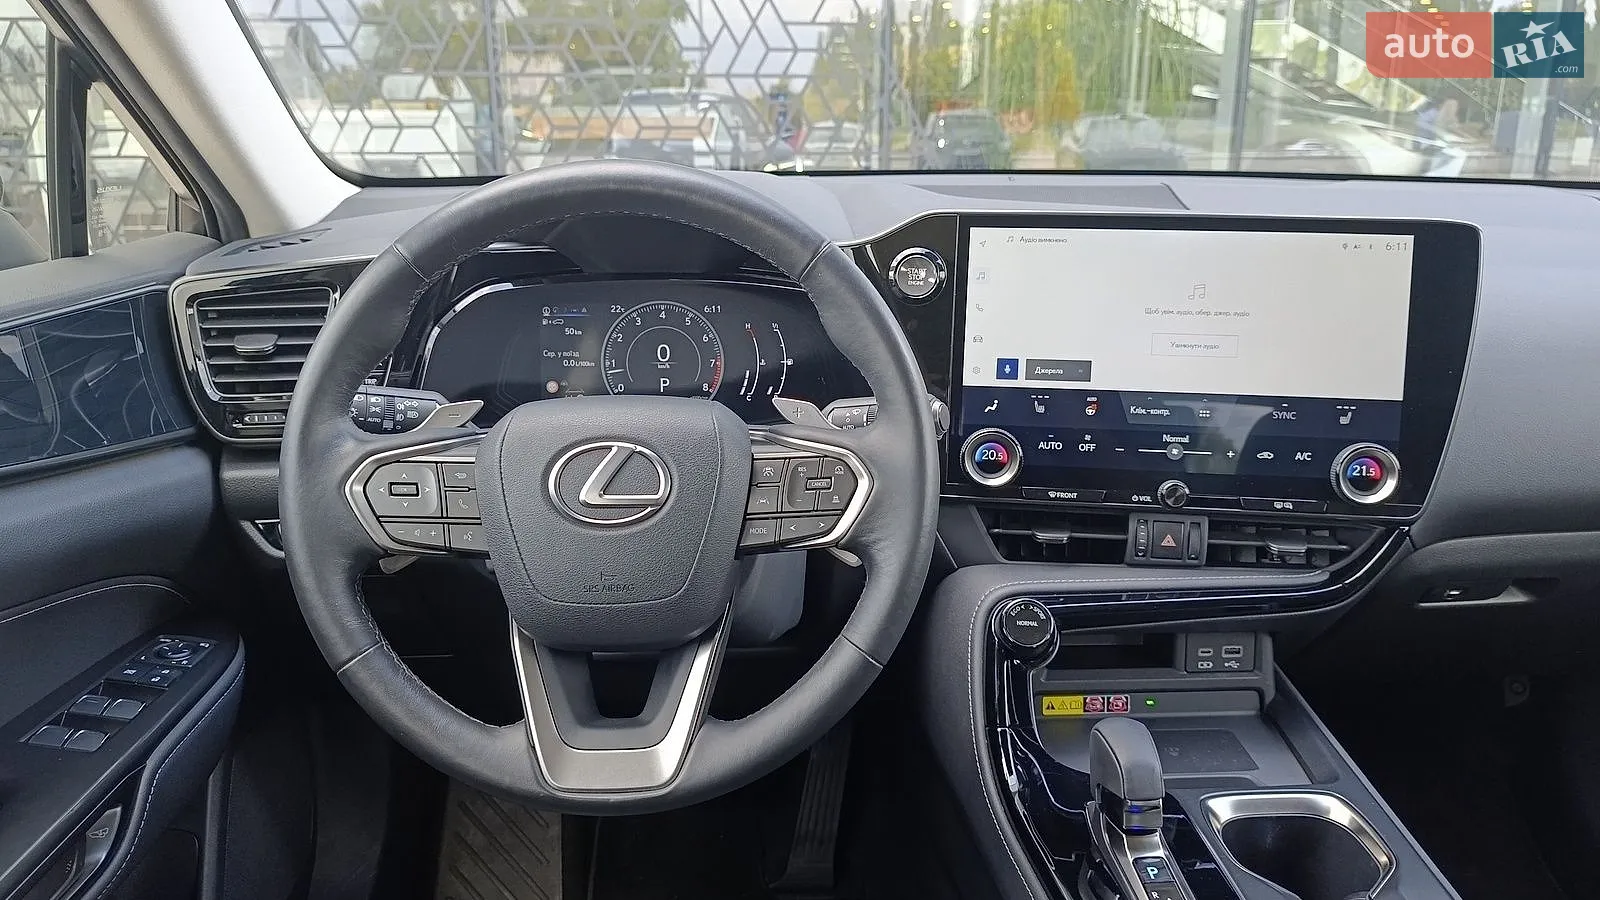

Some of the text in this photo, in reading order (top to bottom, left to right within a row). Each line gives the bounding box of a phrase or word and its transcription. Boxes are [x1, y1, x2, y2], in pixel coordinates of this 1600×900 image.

[1385, 241, 1408, 251] 6:11
[907, 267, 927, 275] START
[704, 304, 721, 313] 6:11
[659, 310, 666, 319] 4
[635, 317, 641, 326] 3
[685, 317, 691, 326] 5
[617, 333, 623, 342] 2
[702, 333, 709, 342] 6
[656, 343, 671, 362] 0
[611, 359, 616, 368] 1
[709, 359, 716, 368] 7
[1034, 366, 1064, 376] Джерела
[618, 383, 625, 392] 0
[660, 377, 670, 393] P
[702, 383, 709, 392] 8
[1272, 410, 1297, 420] SYNC
[1162, 434, 1190, 443] Normal
[1038, 441, 1063, 450] AUTO
[1078, 443, 1097, 452] OFF
[981, 449, 1003, 461] 20.5
[1294, 451, 1312, 461] A/C
[1352, 464, 1376, 478] 21.5
[1055, 491, 1078, 499] FRONT
[601, 584, 635, 593] AIRBAG
[1010, 606, 1021, 616] ECO
[1146, 866, 1159, 880] P
[1151, 891, 1160, 899] R
